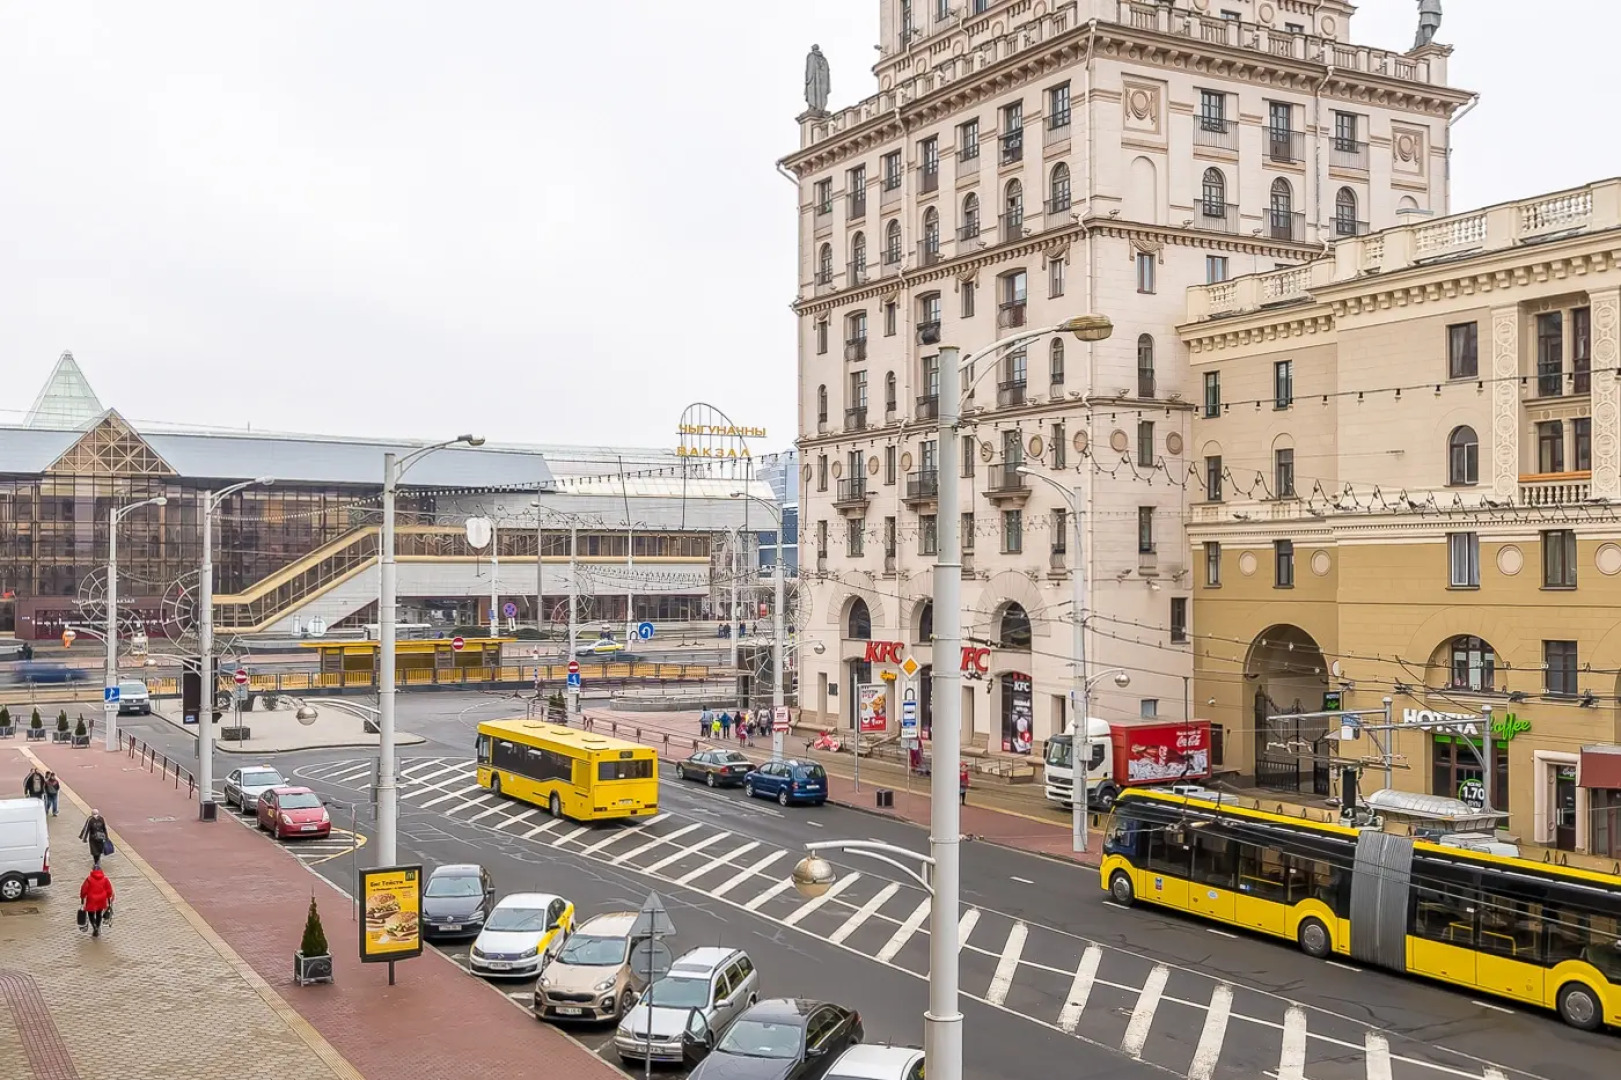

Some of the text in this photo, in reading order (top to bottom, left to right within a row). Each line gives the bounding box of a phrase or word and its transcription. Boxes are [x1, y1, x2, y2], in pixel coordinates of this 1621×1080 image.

[678, 424, 767, 437] ЧЫГУНАЧНЫ
[676, 446, 751, 458] ВАКЗАЛ
[864, 641, 904, 664] KFC
[961, 647, 990, 671] FC
[1013, 681, 1030, 692] KFC
[1463, 786, 1485, 800] 1.70
